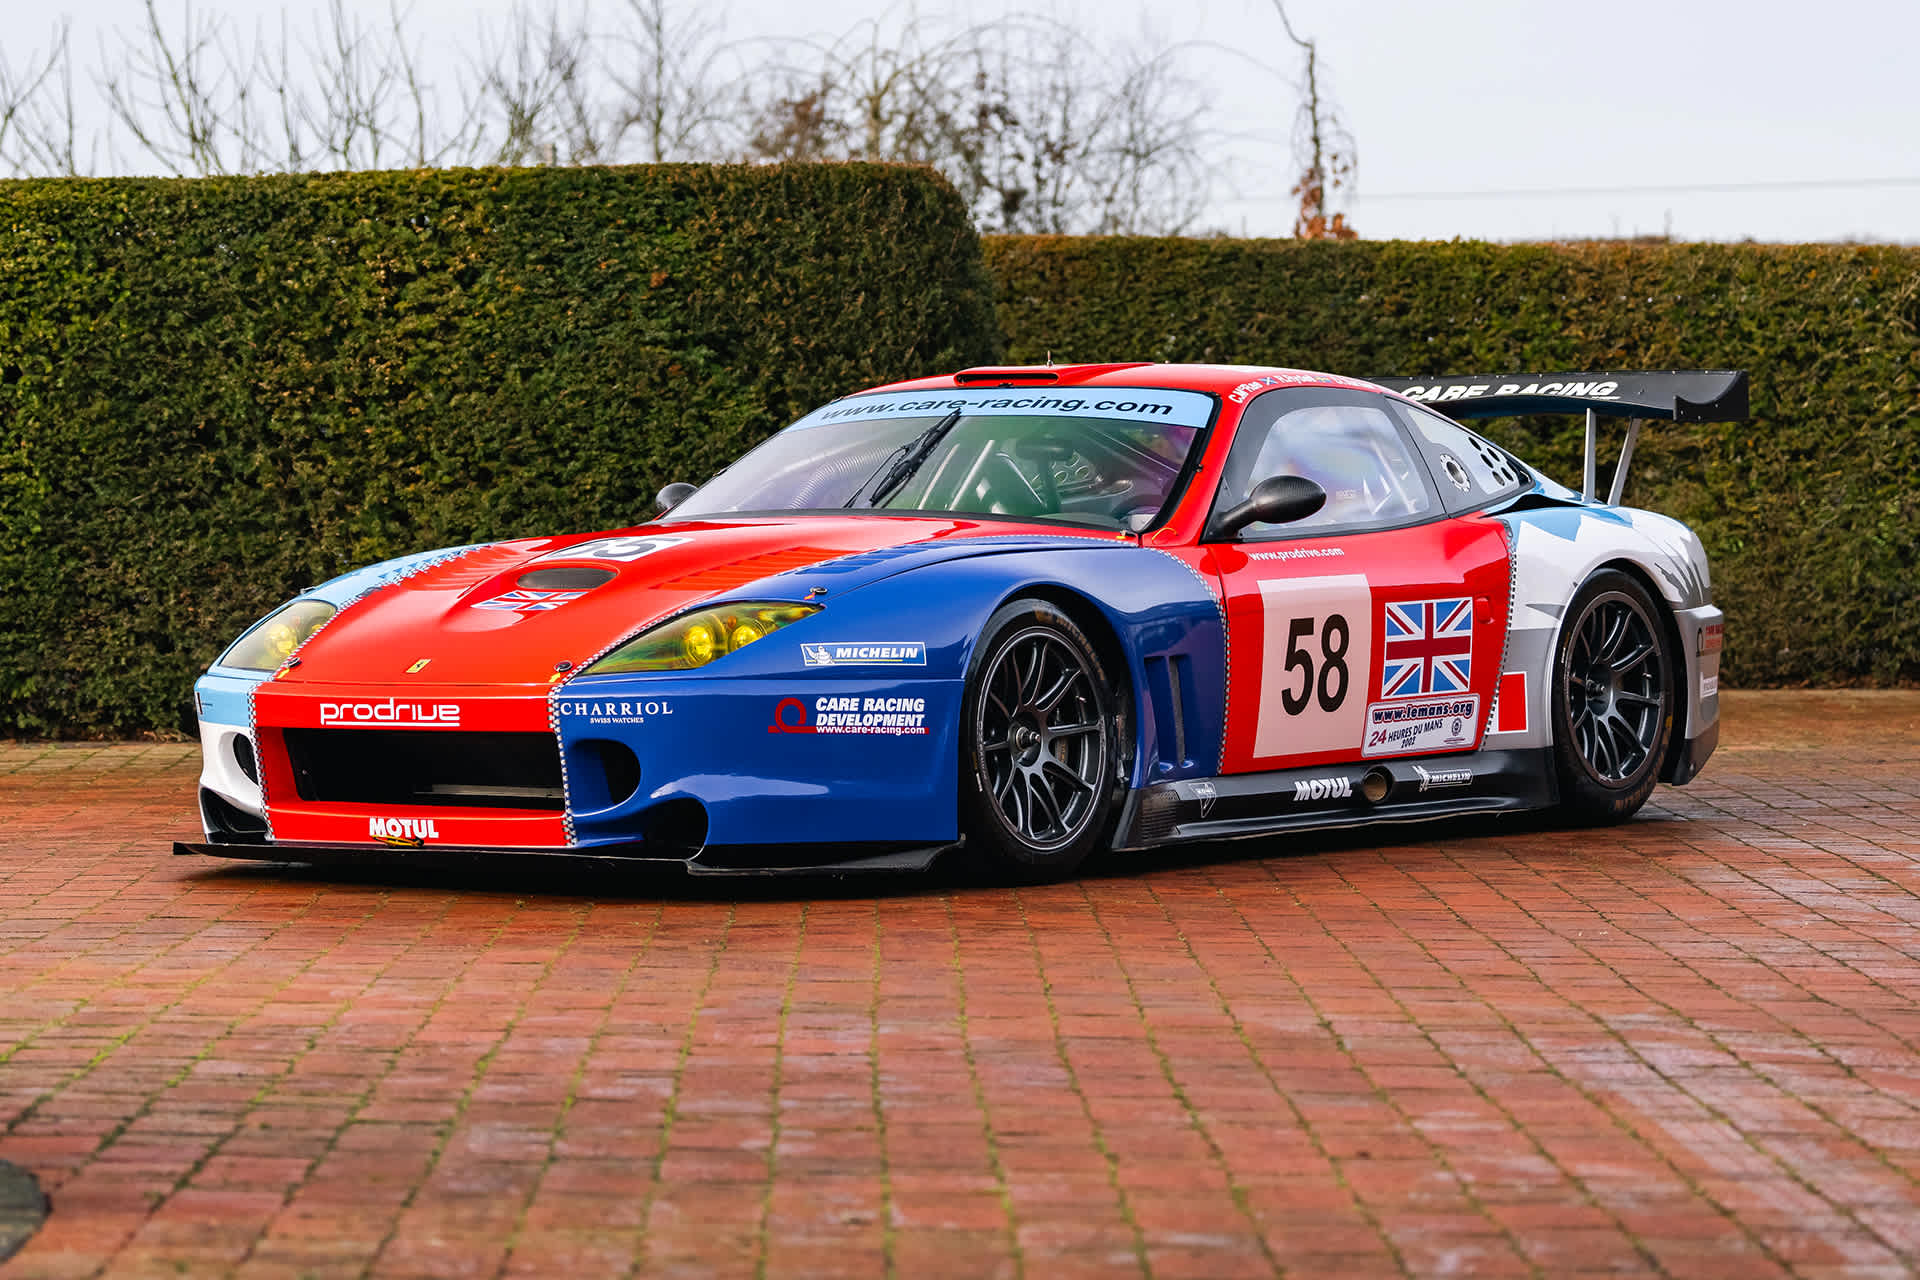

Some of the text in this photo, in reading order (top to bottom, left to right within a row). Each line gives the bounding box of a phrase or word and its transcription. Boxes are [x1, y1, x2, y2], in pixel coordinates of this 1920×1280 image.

[821, 395, 1173, 420] www.care-racing.com
[1249, 547, 1345, 561] www.prodrive.com
[835, 647, 918, 659] MICHELIN
[1281, 613, 1350, 716] 58
[319, 697, 461, 726] prodrive
[560, 701, 673, 716] CHARRIOL
[816, 697, 925, 712] CARE RACING
[1374, 702, 1473, 721] www.lemans.org
[816, 713, 926, 727] DEVELOPMENT
[816, 726, 926, 736] www.care-racing.com
[1368, 718, 1444, 747] 24 HEURES DU MANS
[1431, 772, 1471, 783] MICHELIN
[1293, 776, 1353, 801] MOTUL
[369, 817, 439, 838] MOTUL
